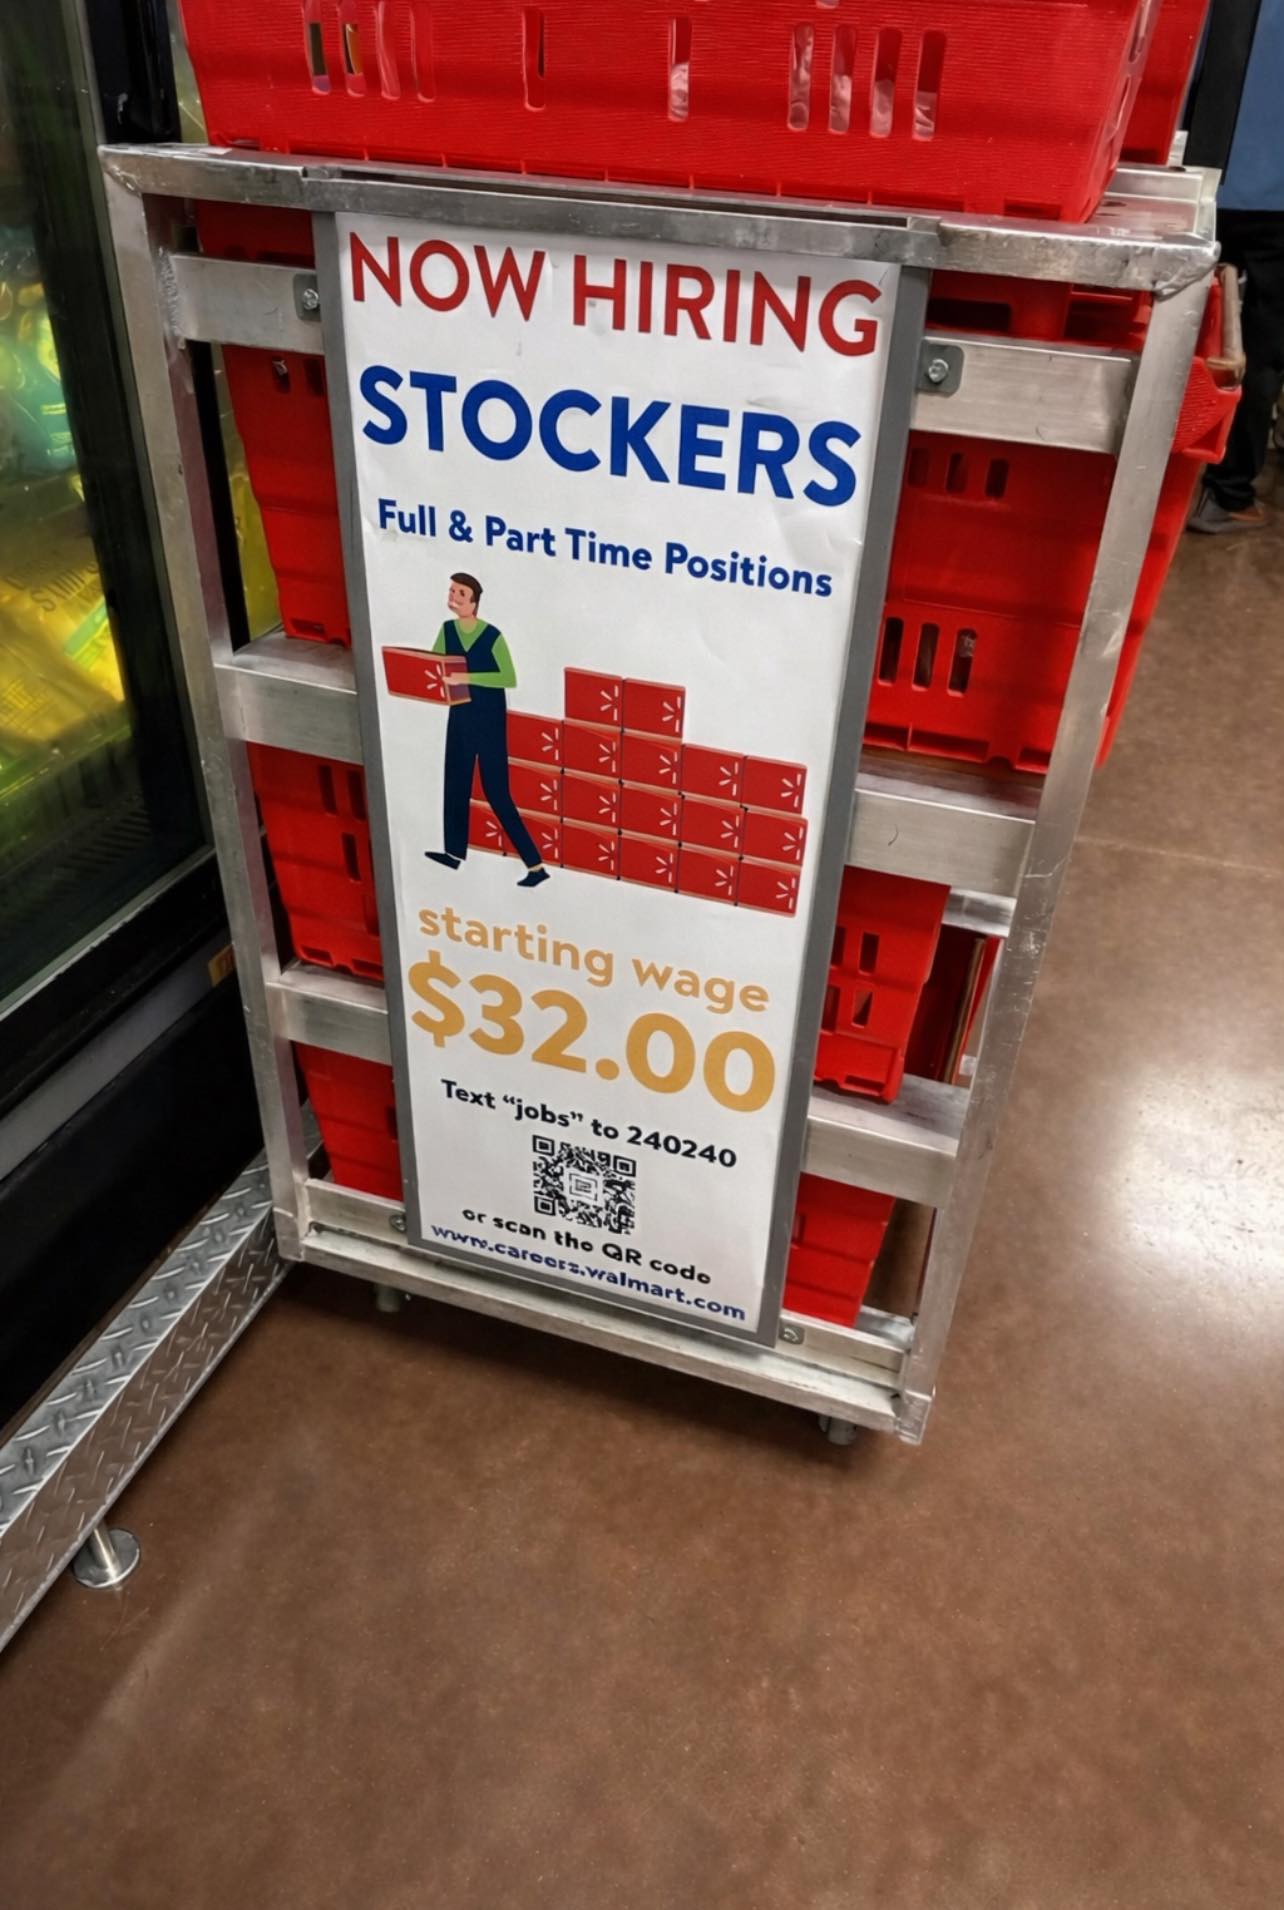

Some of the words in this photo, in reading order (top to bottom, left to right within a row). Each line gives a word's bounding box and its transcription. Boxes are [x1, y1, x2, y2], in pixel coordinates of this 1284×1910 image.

[348, 231, 546, 321] NOW
[572, 254, 881, 357] HIRING
[359, 364, 862, 506] STOCKERS
[378, 498, 436, 537] Full
[447, 510, 474, 542] &
[484, 514, 555, 557] Part
[565, 527, 652, 570] Time
[664, 541, 832, 596] Positions
[418, 906, 614, 988] starting
[632, 958, 770, 1014] wage
[408, 950, 776, 1113] $32.00
[441, 1079, 497, 1110] Text
[590, 1117, 619, 1141] to
[627, 1125, 738, 1168] 240240
[430, 1223, 747, 1321] www.careers.walmart.com
[462, 1207, 486, 1223] or
[493, 1216, 547, 1241] scan
[554, 1231, 594, 1253] the
[601, 1242, 643, 1268] QR
[649, 1256, 712, 1286] code
